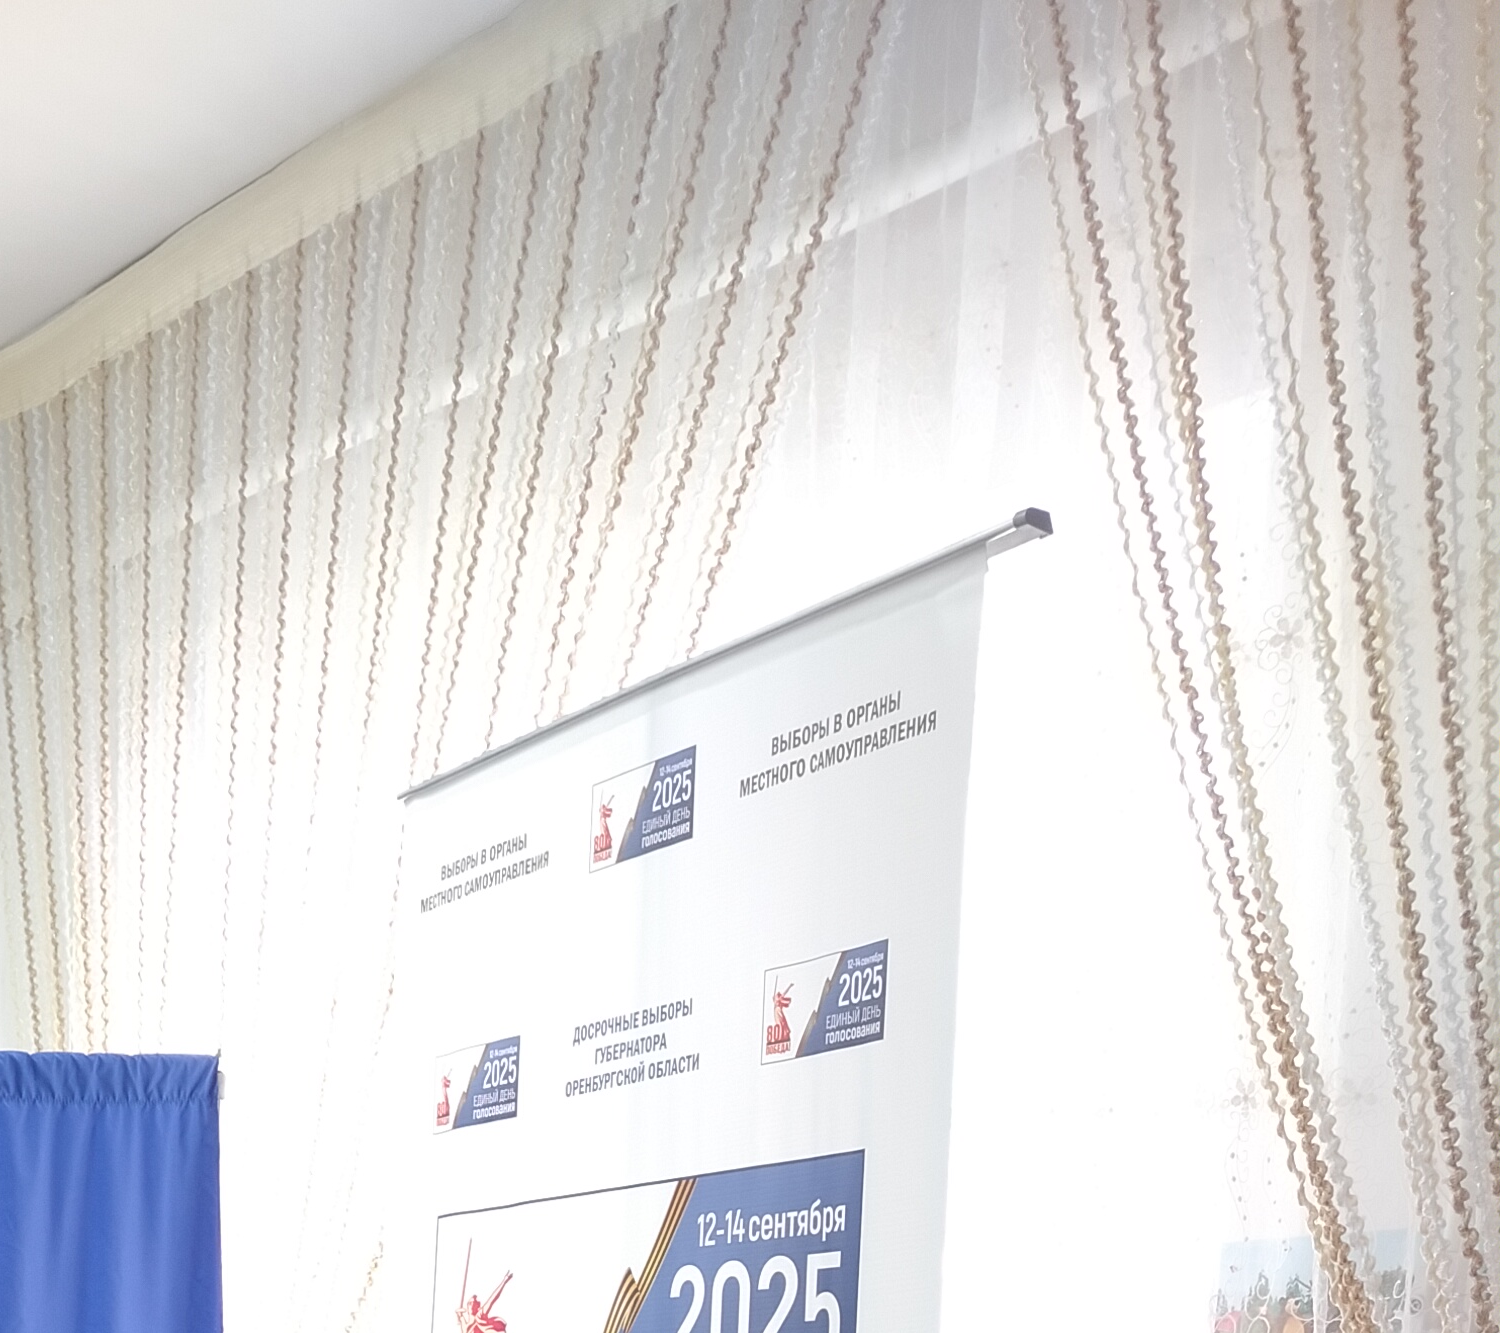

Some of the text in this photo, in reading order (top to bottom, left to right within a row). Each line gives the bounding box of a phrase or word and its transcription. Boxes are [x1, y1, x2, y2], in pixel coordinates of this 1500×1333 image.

[771, 690, 901, 756] ВЫБОРЫ В ОРГАНЫ
[739, 710, 937, 798] МЕСТНОГО САМОУПРАВЛЕНИЯ
[652, 769, 692, 812] 2025
[441, 833, 527, 881] ВЫБОРЫ В ОРГАНЫ
[421, 851, 549, 914] МЕСТНОГО САМОУПРАВЛЕНИЯ
[838, 965, 883, 1007] 2025
[573, 997, 693, 1047] ДОСРОЧНЫЕ ВЫБОРЫ
[767, 1024, 780, 1043] 80
[826, 1004, 881, 1030] ЕДИНЫЙ ДЕНЬ
[595, 1032, 667, 1065] ГУБЕРНАТОРА
[482, 1056, 517, 1089] 2025
[565, 1053, 700, 1097] ОРЕНБУРГСКОЙ ОБЛАСТИ
[697, 1199, 846, 1247] 12-14 сентября
